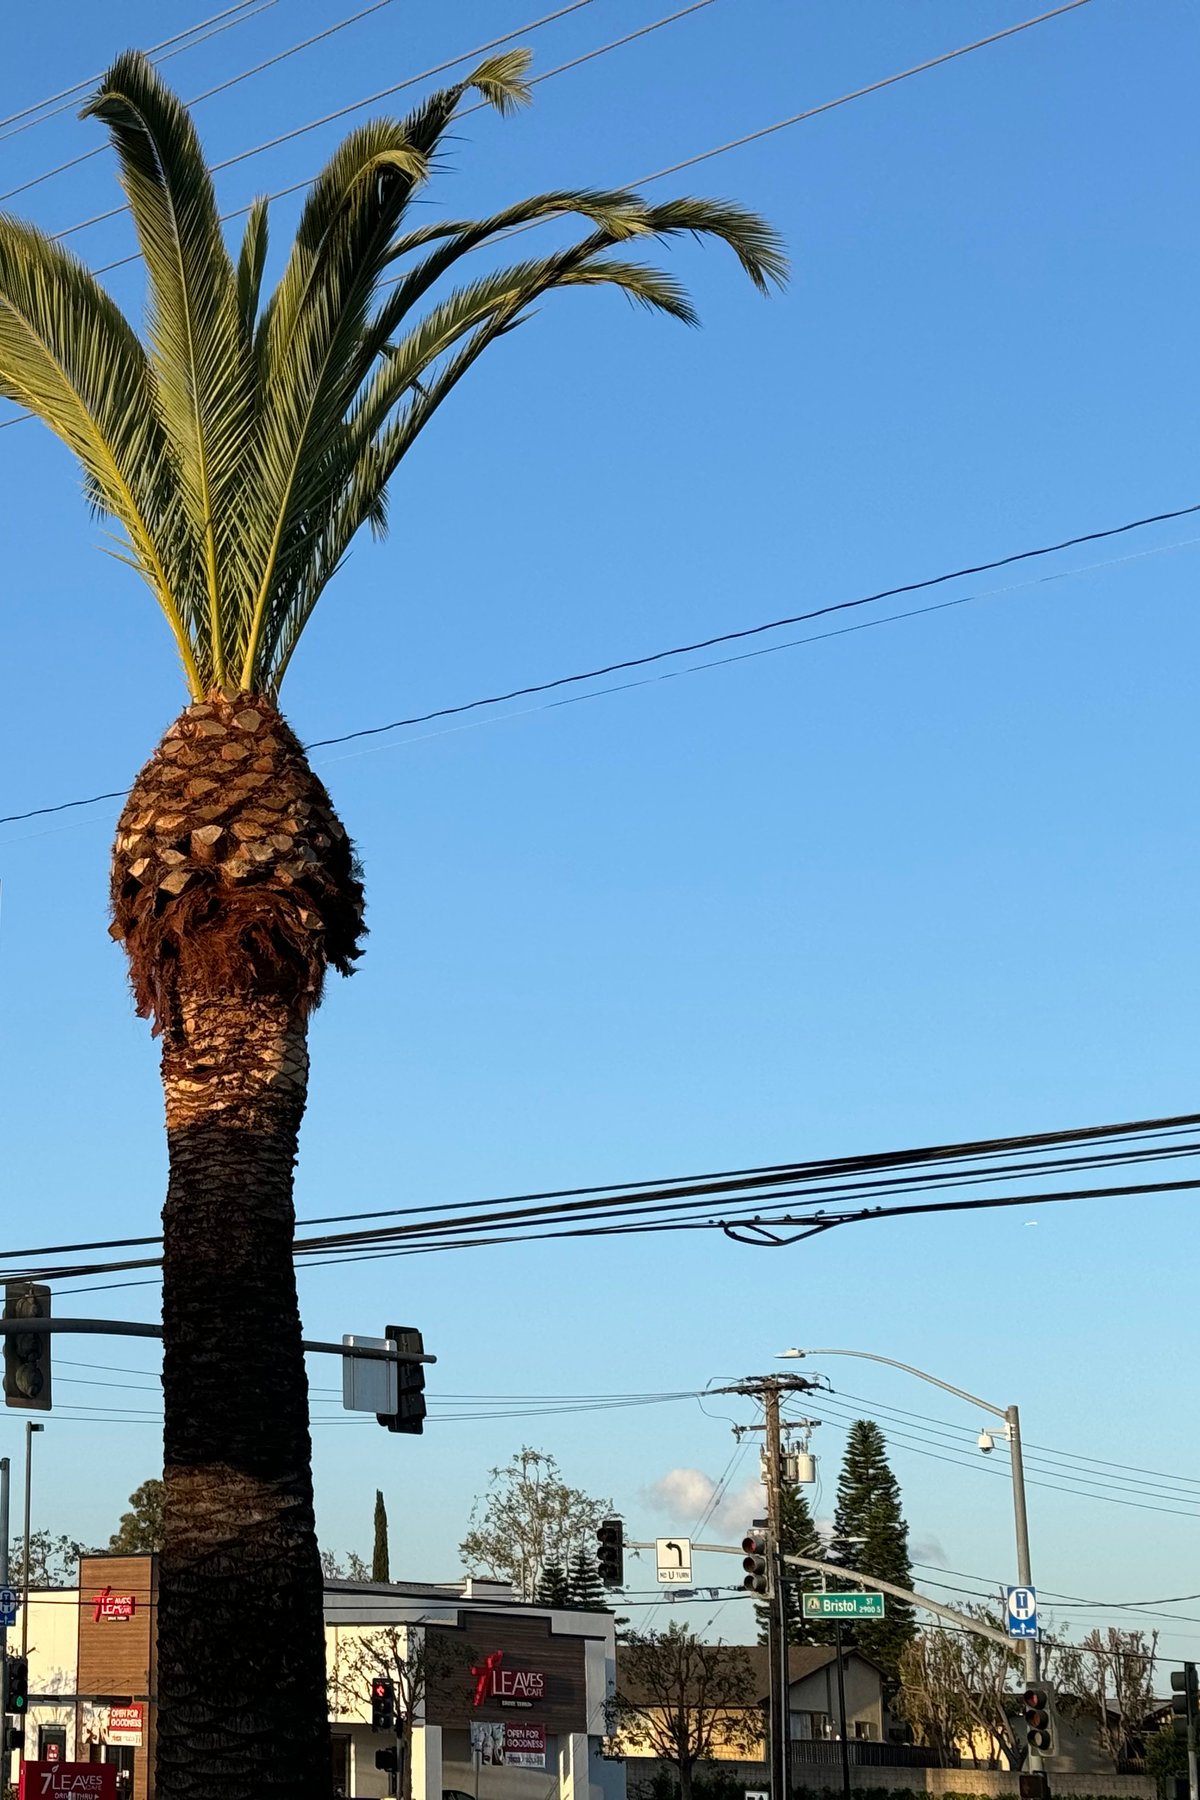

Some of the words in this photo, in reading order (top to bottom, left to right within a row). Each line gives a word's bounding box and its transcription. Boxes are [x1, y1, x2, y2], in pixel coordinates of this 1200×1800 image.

[668, 1571, 675, 1580] U
[823, 1599, 857, 1612] Bristol
[866, 1597, 873, 1605] ST
[492, 1670, 544, 1696] LEAVES
[526, 1687, 543, 1697] CAFE
[507, 1729, 525, 1738] OPEN
[525, 1729, 539, 1739] FOR
[506, 1739, 543, 1748] GOODNESS
[52, 1775, 103, 1790] LEAVES
[54, 1792, 76, 1800] DRIV
[76, 1792, 93, 1800] THRU
